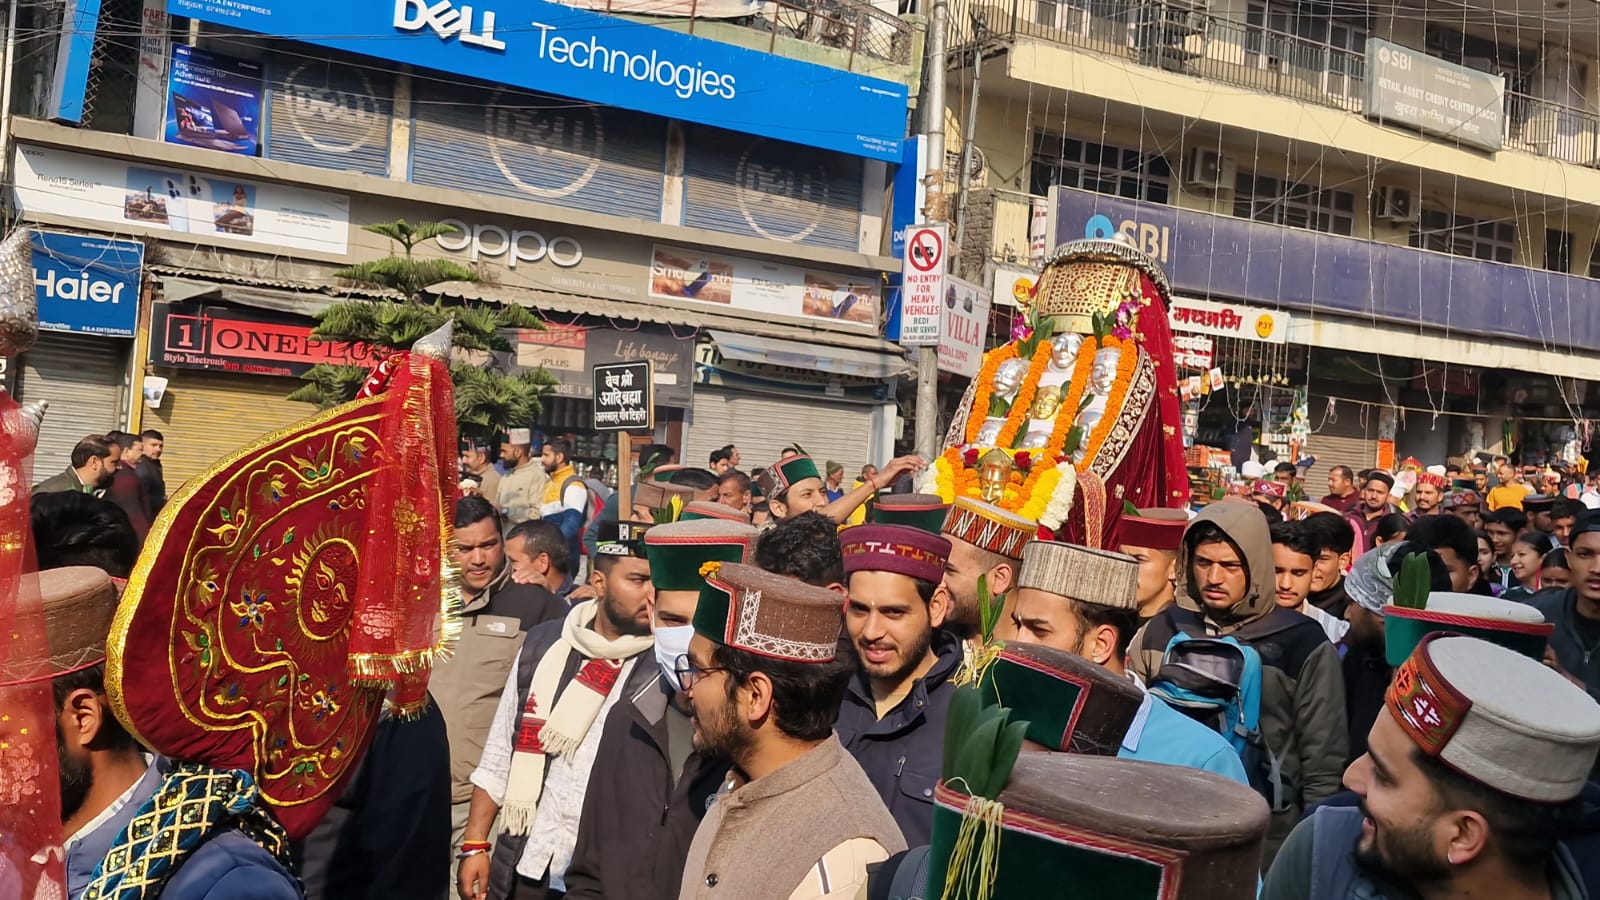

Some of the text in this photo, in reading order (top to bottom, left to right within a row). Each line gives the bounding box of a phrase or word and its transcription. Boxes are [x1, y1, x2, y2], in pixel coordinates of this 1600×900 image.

[144, 7, 166, 21] CARE
[393, 0, 736, 99] DELL Technologies
[175, 61, 215, 76] Engineered
[1391, 51, 1412, 72] SBI
[174, 70, 211, 83] Adventure
[1378, 77, 1402, 94] RETAIL
[1402, 84, 1424, 99] ASSET
[1424, 90, 1450, 107] CREDIT
[1450, 98, 1475, 116] CENTRE
[69, 178, 94, 189] Series
[435, 218, 583, 268] oppo
[1119, 219, 1170, 264] SBI
[32, 268, 125, 304] Haier
[920, 274, 940, 282] ENTRY
[916, 284, 931, 293] FOR
[904, 306, 940, 316] VEHICLES
[948, 311, 980, 347] VILLA
[164, 353, 226, 366] Style Electronic
[615, 340, 678, 368] Life banaye
[605, 369, 634, 388] देव श्री
[559, 384, 574, 394] USE
